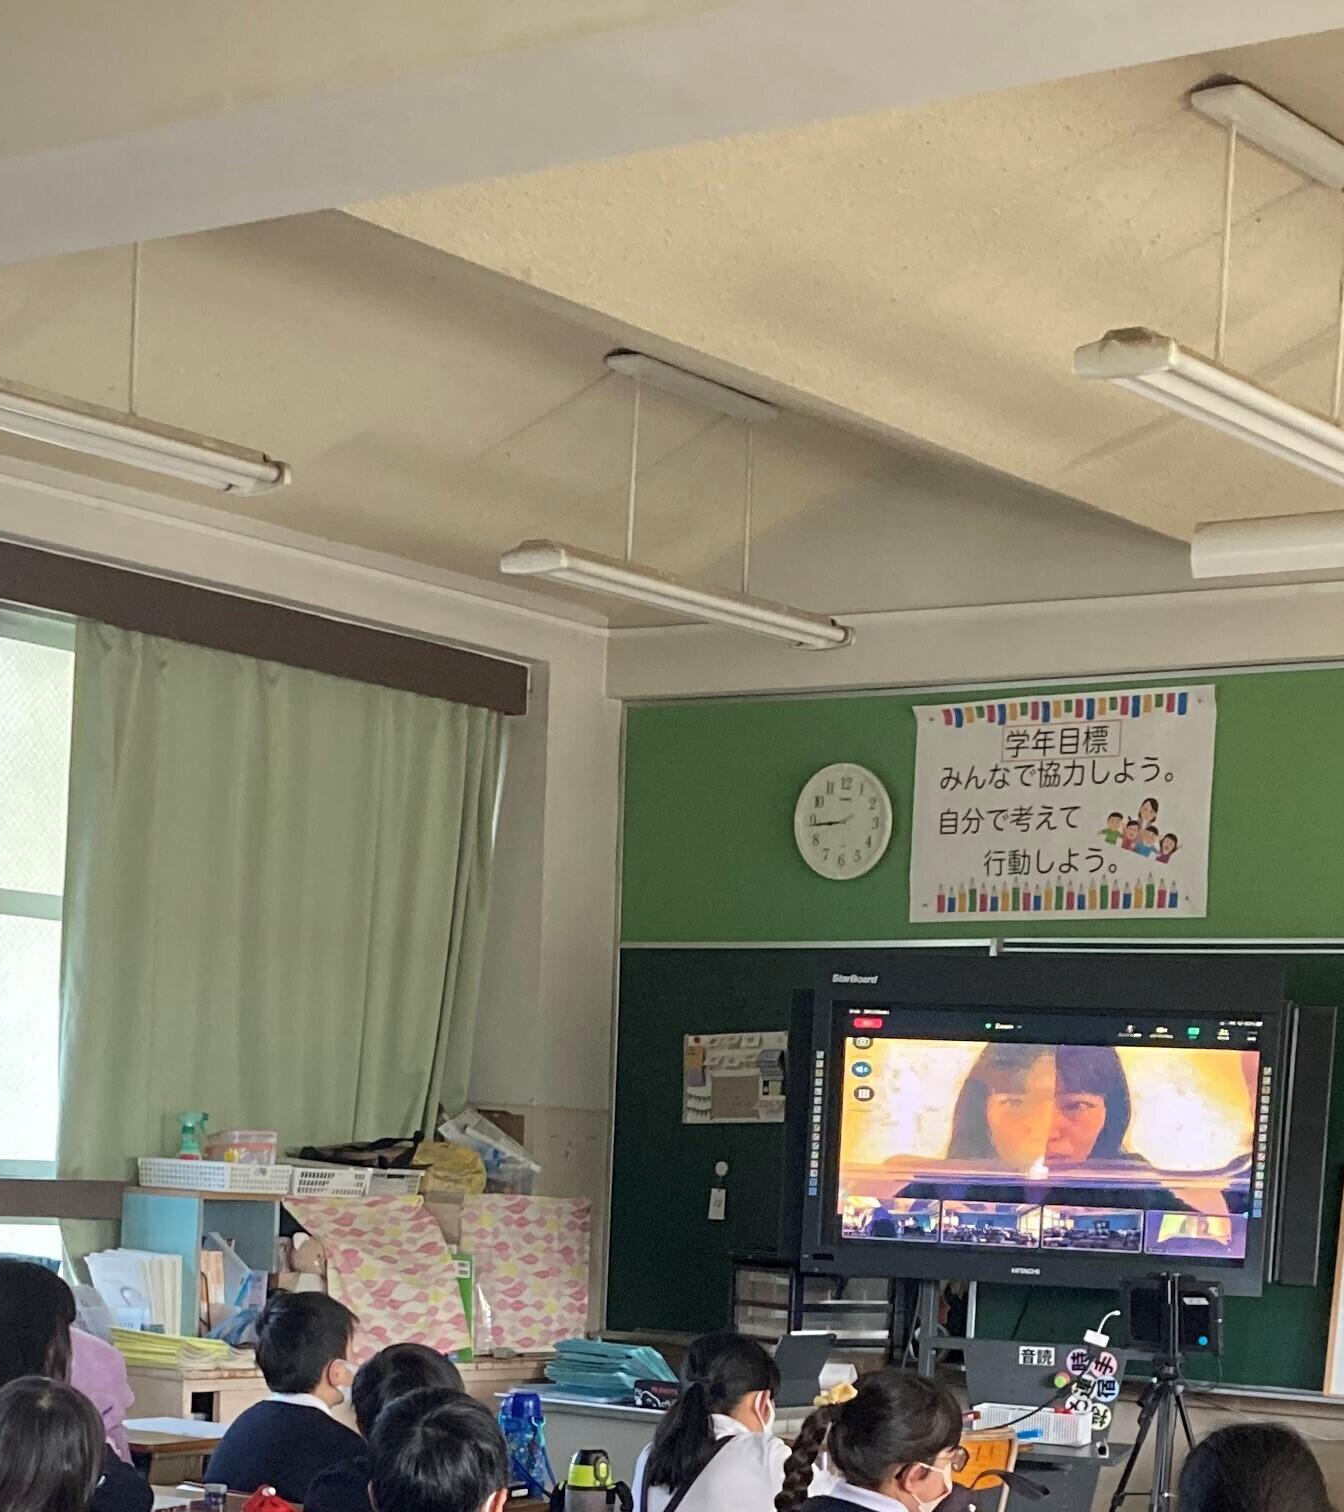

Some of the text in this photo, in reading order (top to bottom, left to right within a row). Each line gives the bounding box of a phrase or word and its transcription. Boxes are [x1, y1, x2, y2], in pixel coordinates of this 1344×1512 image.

[1004, 725, 1109, 759] 学年目標
[939, 756, 1174, 791] みんなで協力しよう。
[841, 777, 853, 790] 12
[814, 796, 824, 808] 10
[869, 797, 876, 810] 2
[872, 817, 879, 830] 3
[939, 804, 1081, 835] 自分で考えて
[812, 834, 819, 846] 8
[865, 835, 872, 848] 4
[823, 848, 830, 860] 7
[838, 854, 845, 866] 6
[854, 850, 861, 862] 5
[983, 848, 1119, 877] 行動しよう。
[832, 974, 878, 984] StarBoard
[1011, 1267, 1040, 1275] HITACHI
[1021, 1348, 1053, 1365] 音読
